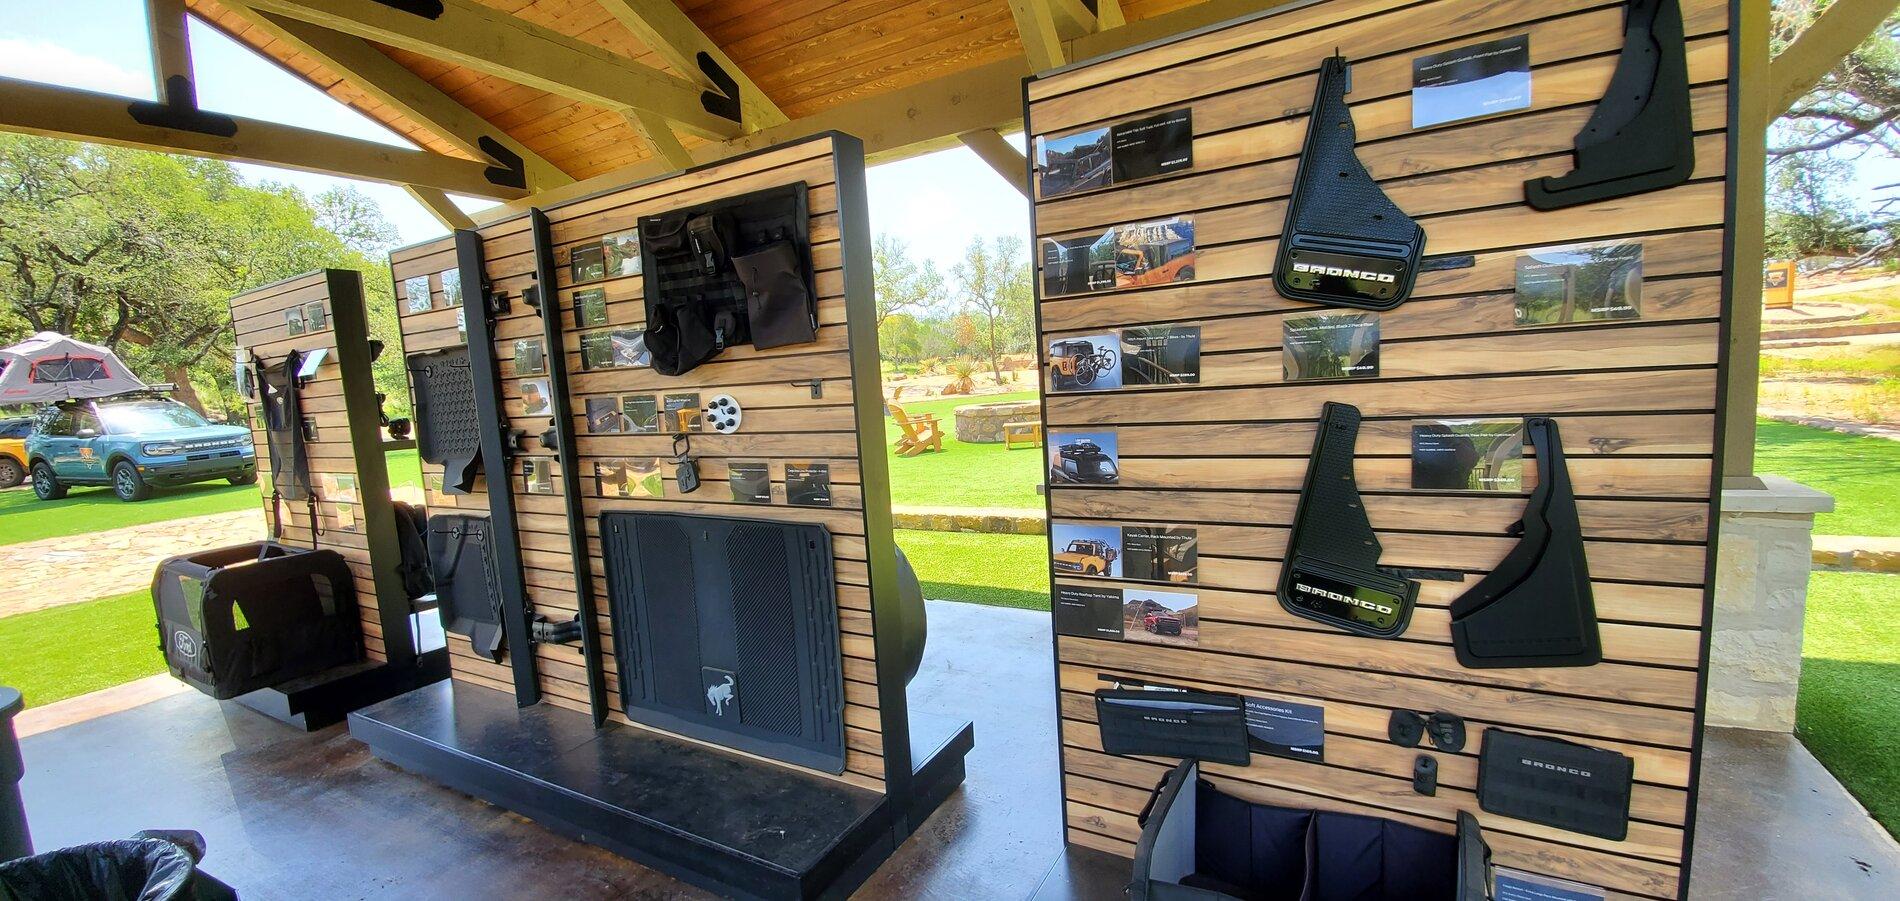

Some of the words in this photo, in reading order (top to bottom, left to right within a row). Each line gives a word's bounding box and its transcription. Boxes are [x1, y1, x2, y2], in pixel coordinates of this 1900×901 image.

[1292, 262, 1395, 283] BRONCO
[1296, 582, 1392, 615] BRONCO
[1255, 703, 1284, 713] Accessories
[1521, 758, 1591, 778] BRONCO
